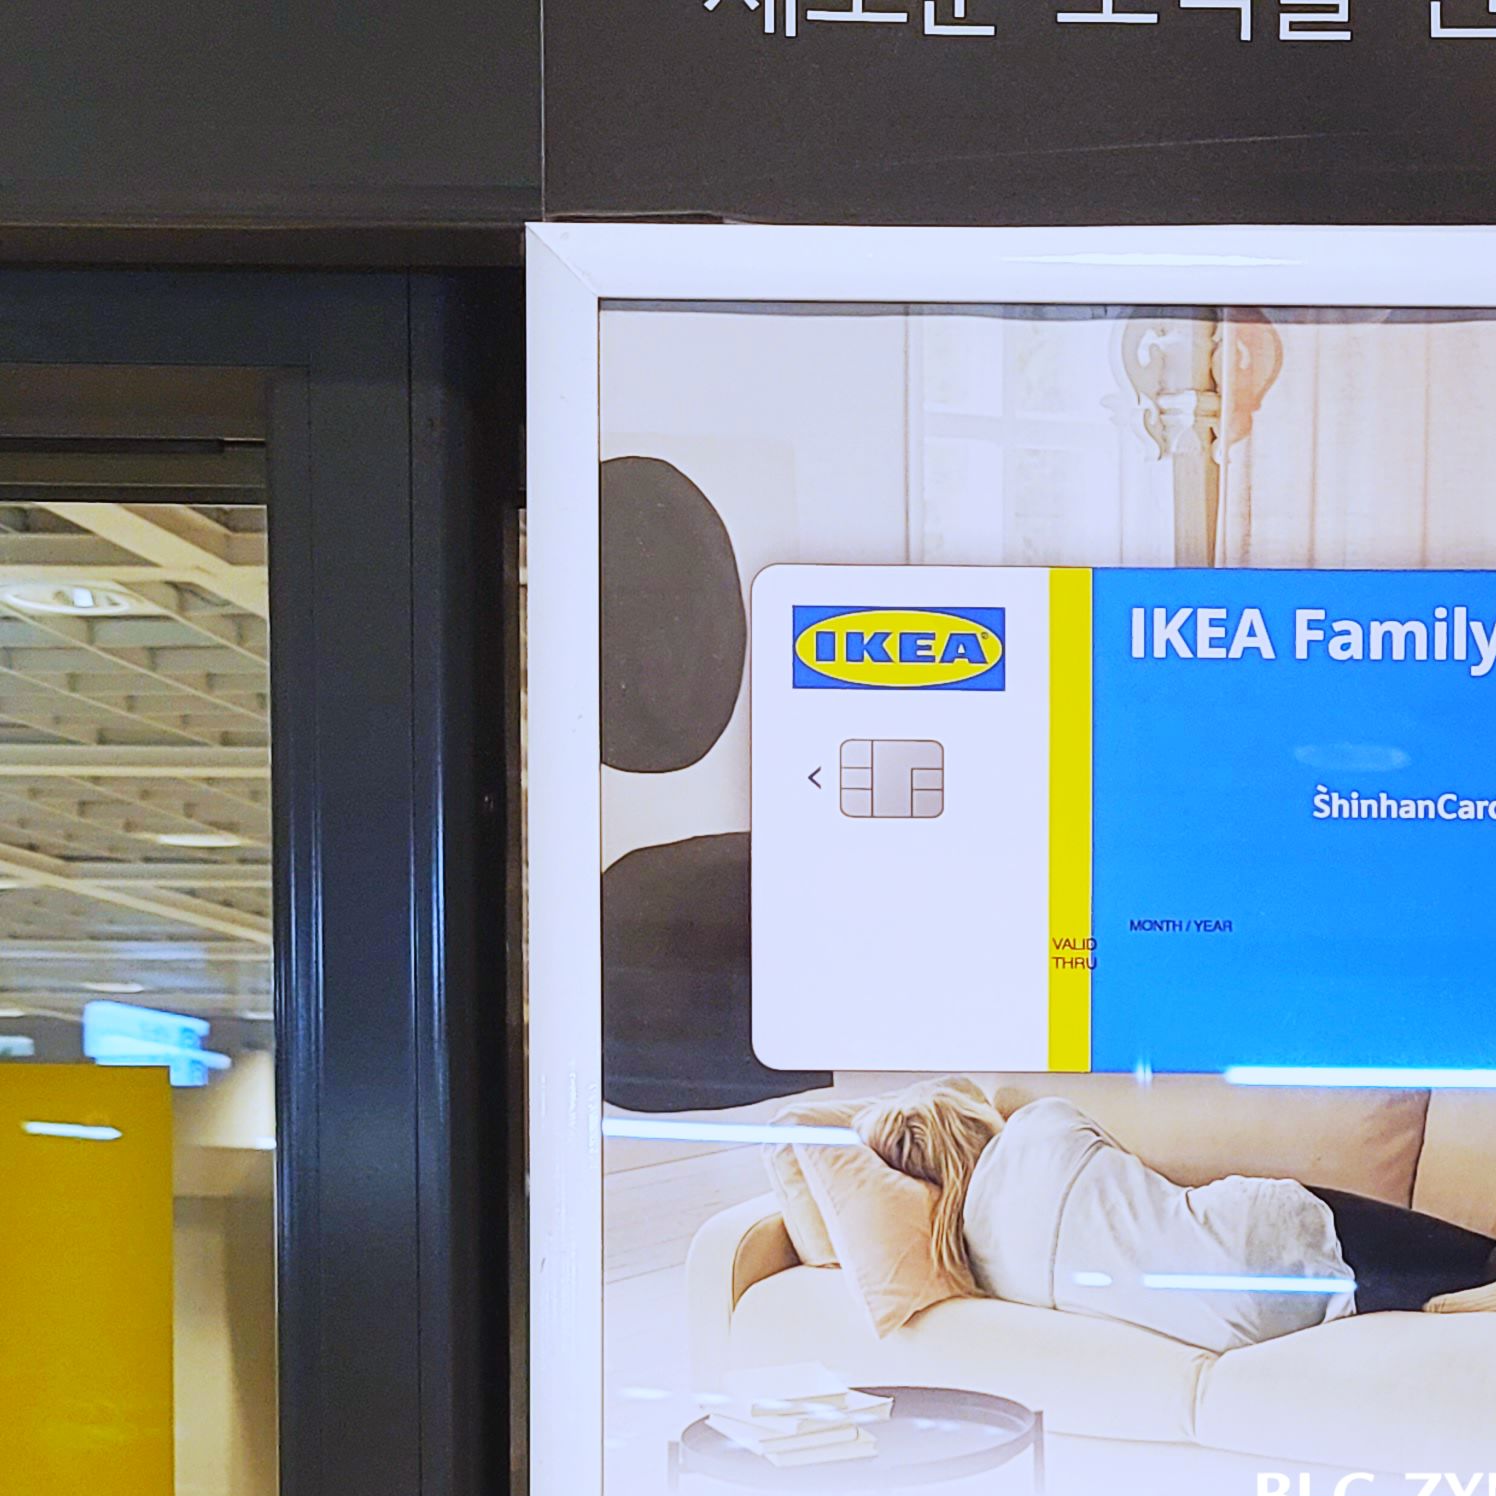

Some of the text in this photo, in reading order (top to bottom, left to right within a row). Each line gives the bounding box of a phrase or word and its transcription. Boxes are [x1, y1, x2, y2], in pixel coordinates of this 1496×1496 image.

[1131, 607, 1276, 661] IKEA
[1129, 919, 1183, 932] MONTH
[1193, 919, 1233, 933] YEAR
[1052, 937, 1098, 951] VALID
[1052, 956, 1098, 970] THRU
